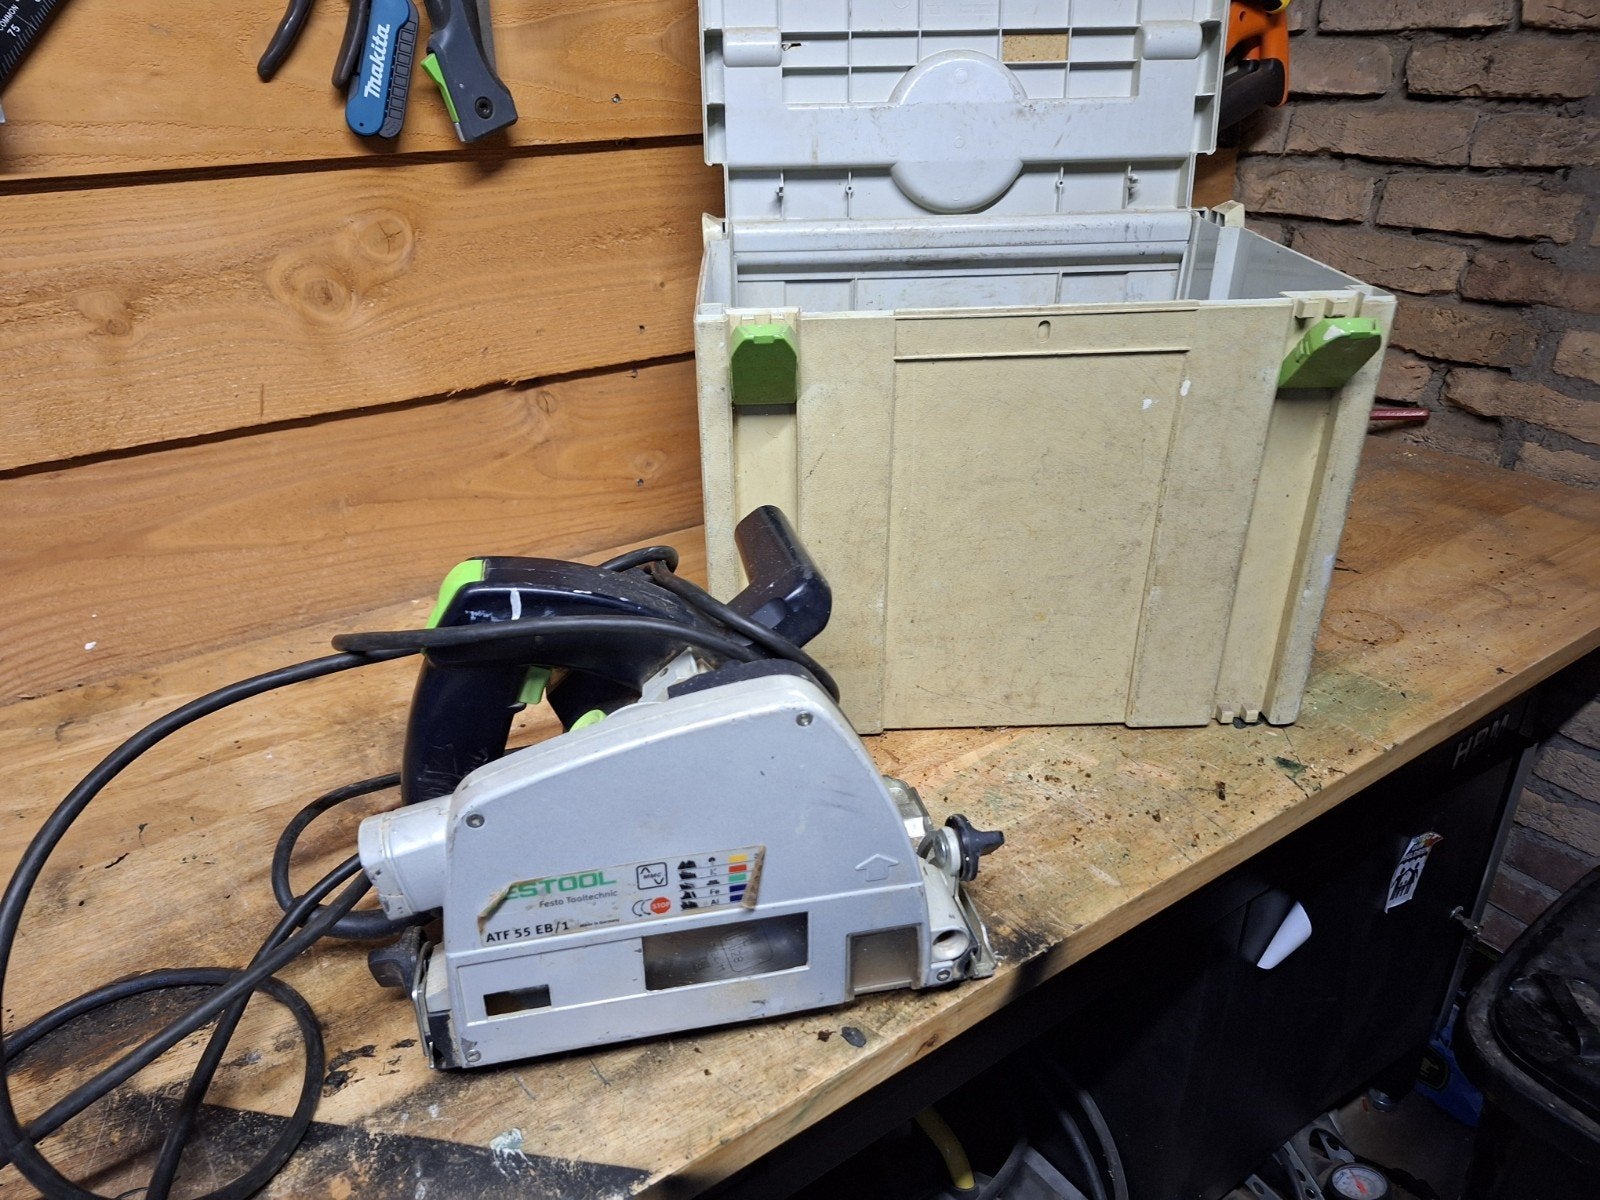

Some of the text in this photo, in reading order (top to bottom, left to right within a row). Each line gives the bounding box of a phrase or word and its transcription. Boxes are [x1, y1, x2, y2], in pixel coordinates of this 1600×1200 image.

[7, 24, 20, 37] 75
[539, 889, 618, 908] Festo Tooltechnic
[486, 920, 570, 943] ATF 55 EB/1
